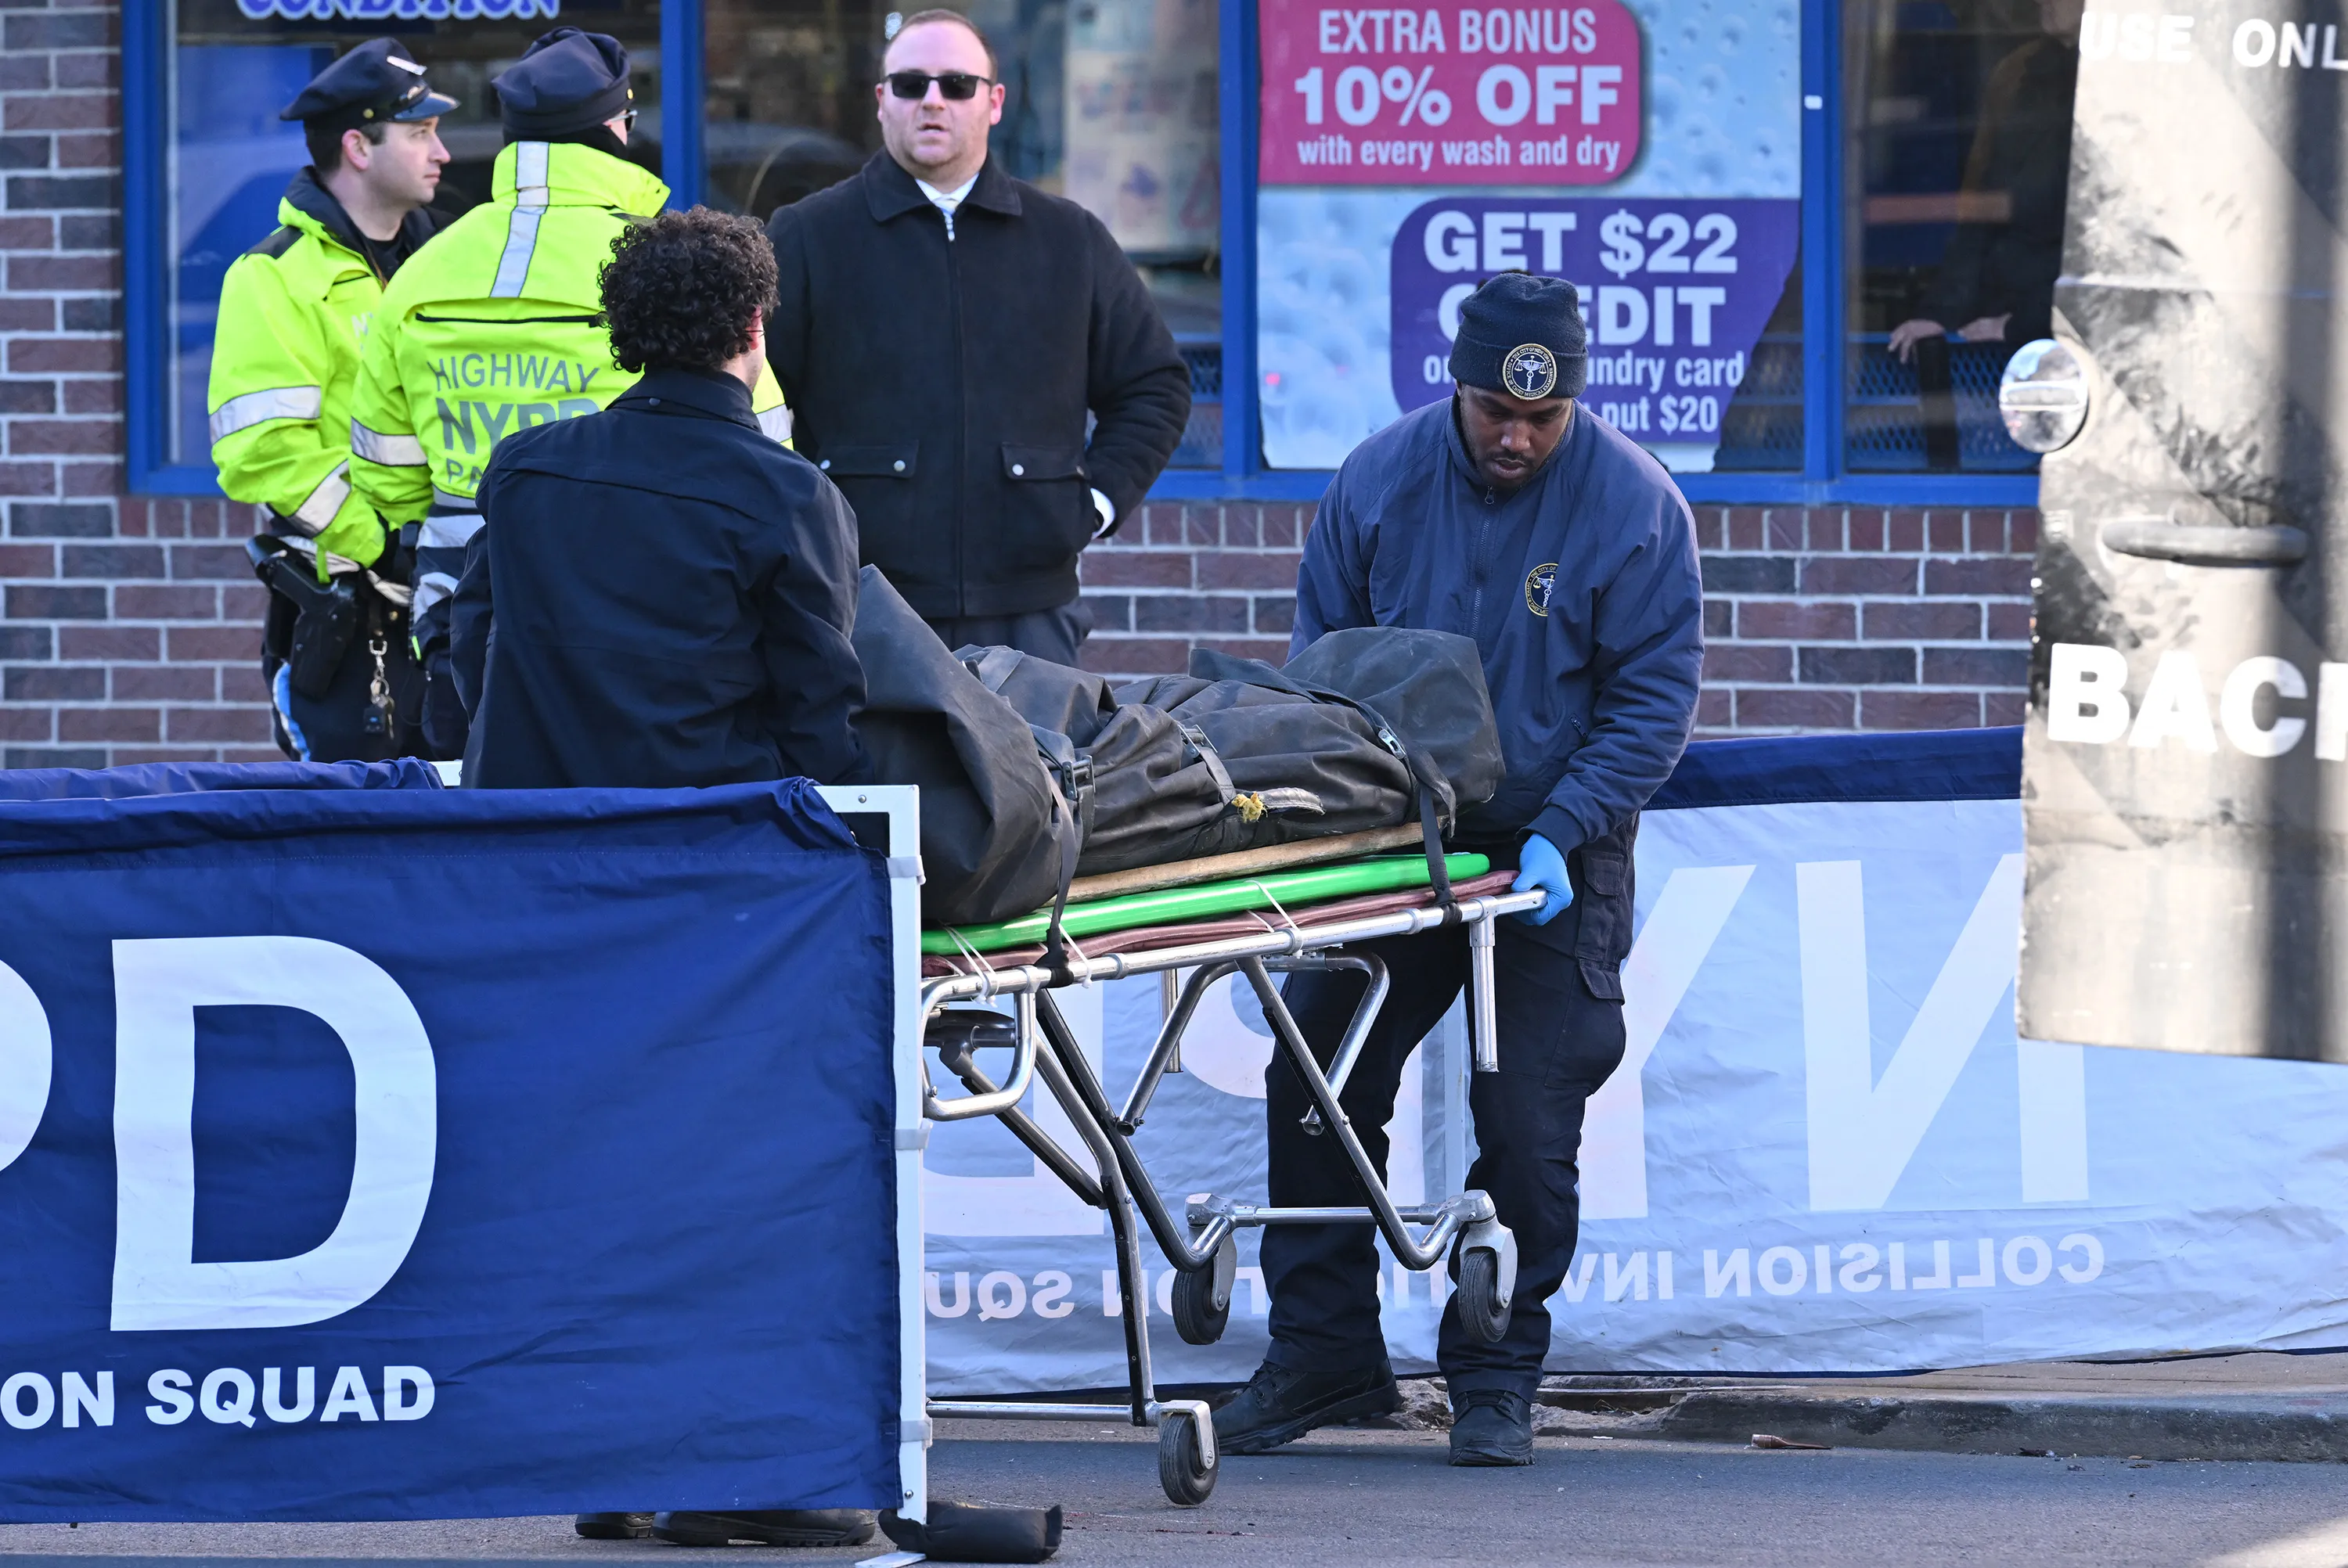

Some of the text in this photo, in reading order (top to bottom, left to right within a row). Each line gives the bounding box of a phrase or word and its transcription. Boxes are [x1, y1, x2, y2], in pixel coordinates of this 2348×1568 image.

[1319, 9, 1597, 53] EXTRA BONUS
[2079, 12, 2195, 63] USE
[1295, 65, 1623, 126] 10% OFF
[1297, 134, 1620, 172] with every wash and dry
[1424, 209, 1738, 279] GET $22
[427, 353, 600, 393] HIGHWAY
[1512, 385, 1525, 395] CHIEF
[1675, 351, 1745, 387] card
[1659, 393, 1719, 436] $20
[145, 1365, 436, 1429] SQUAD
